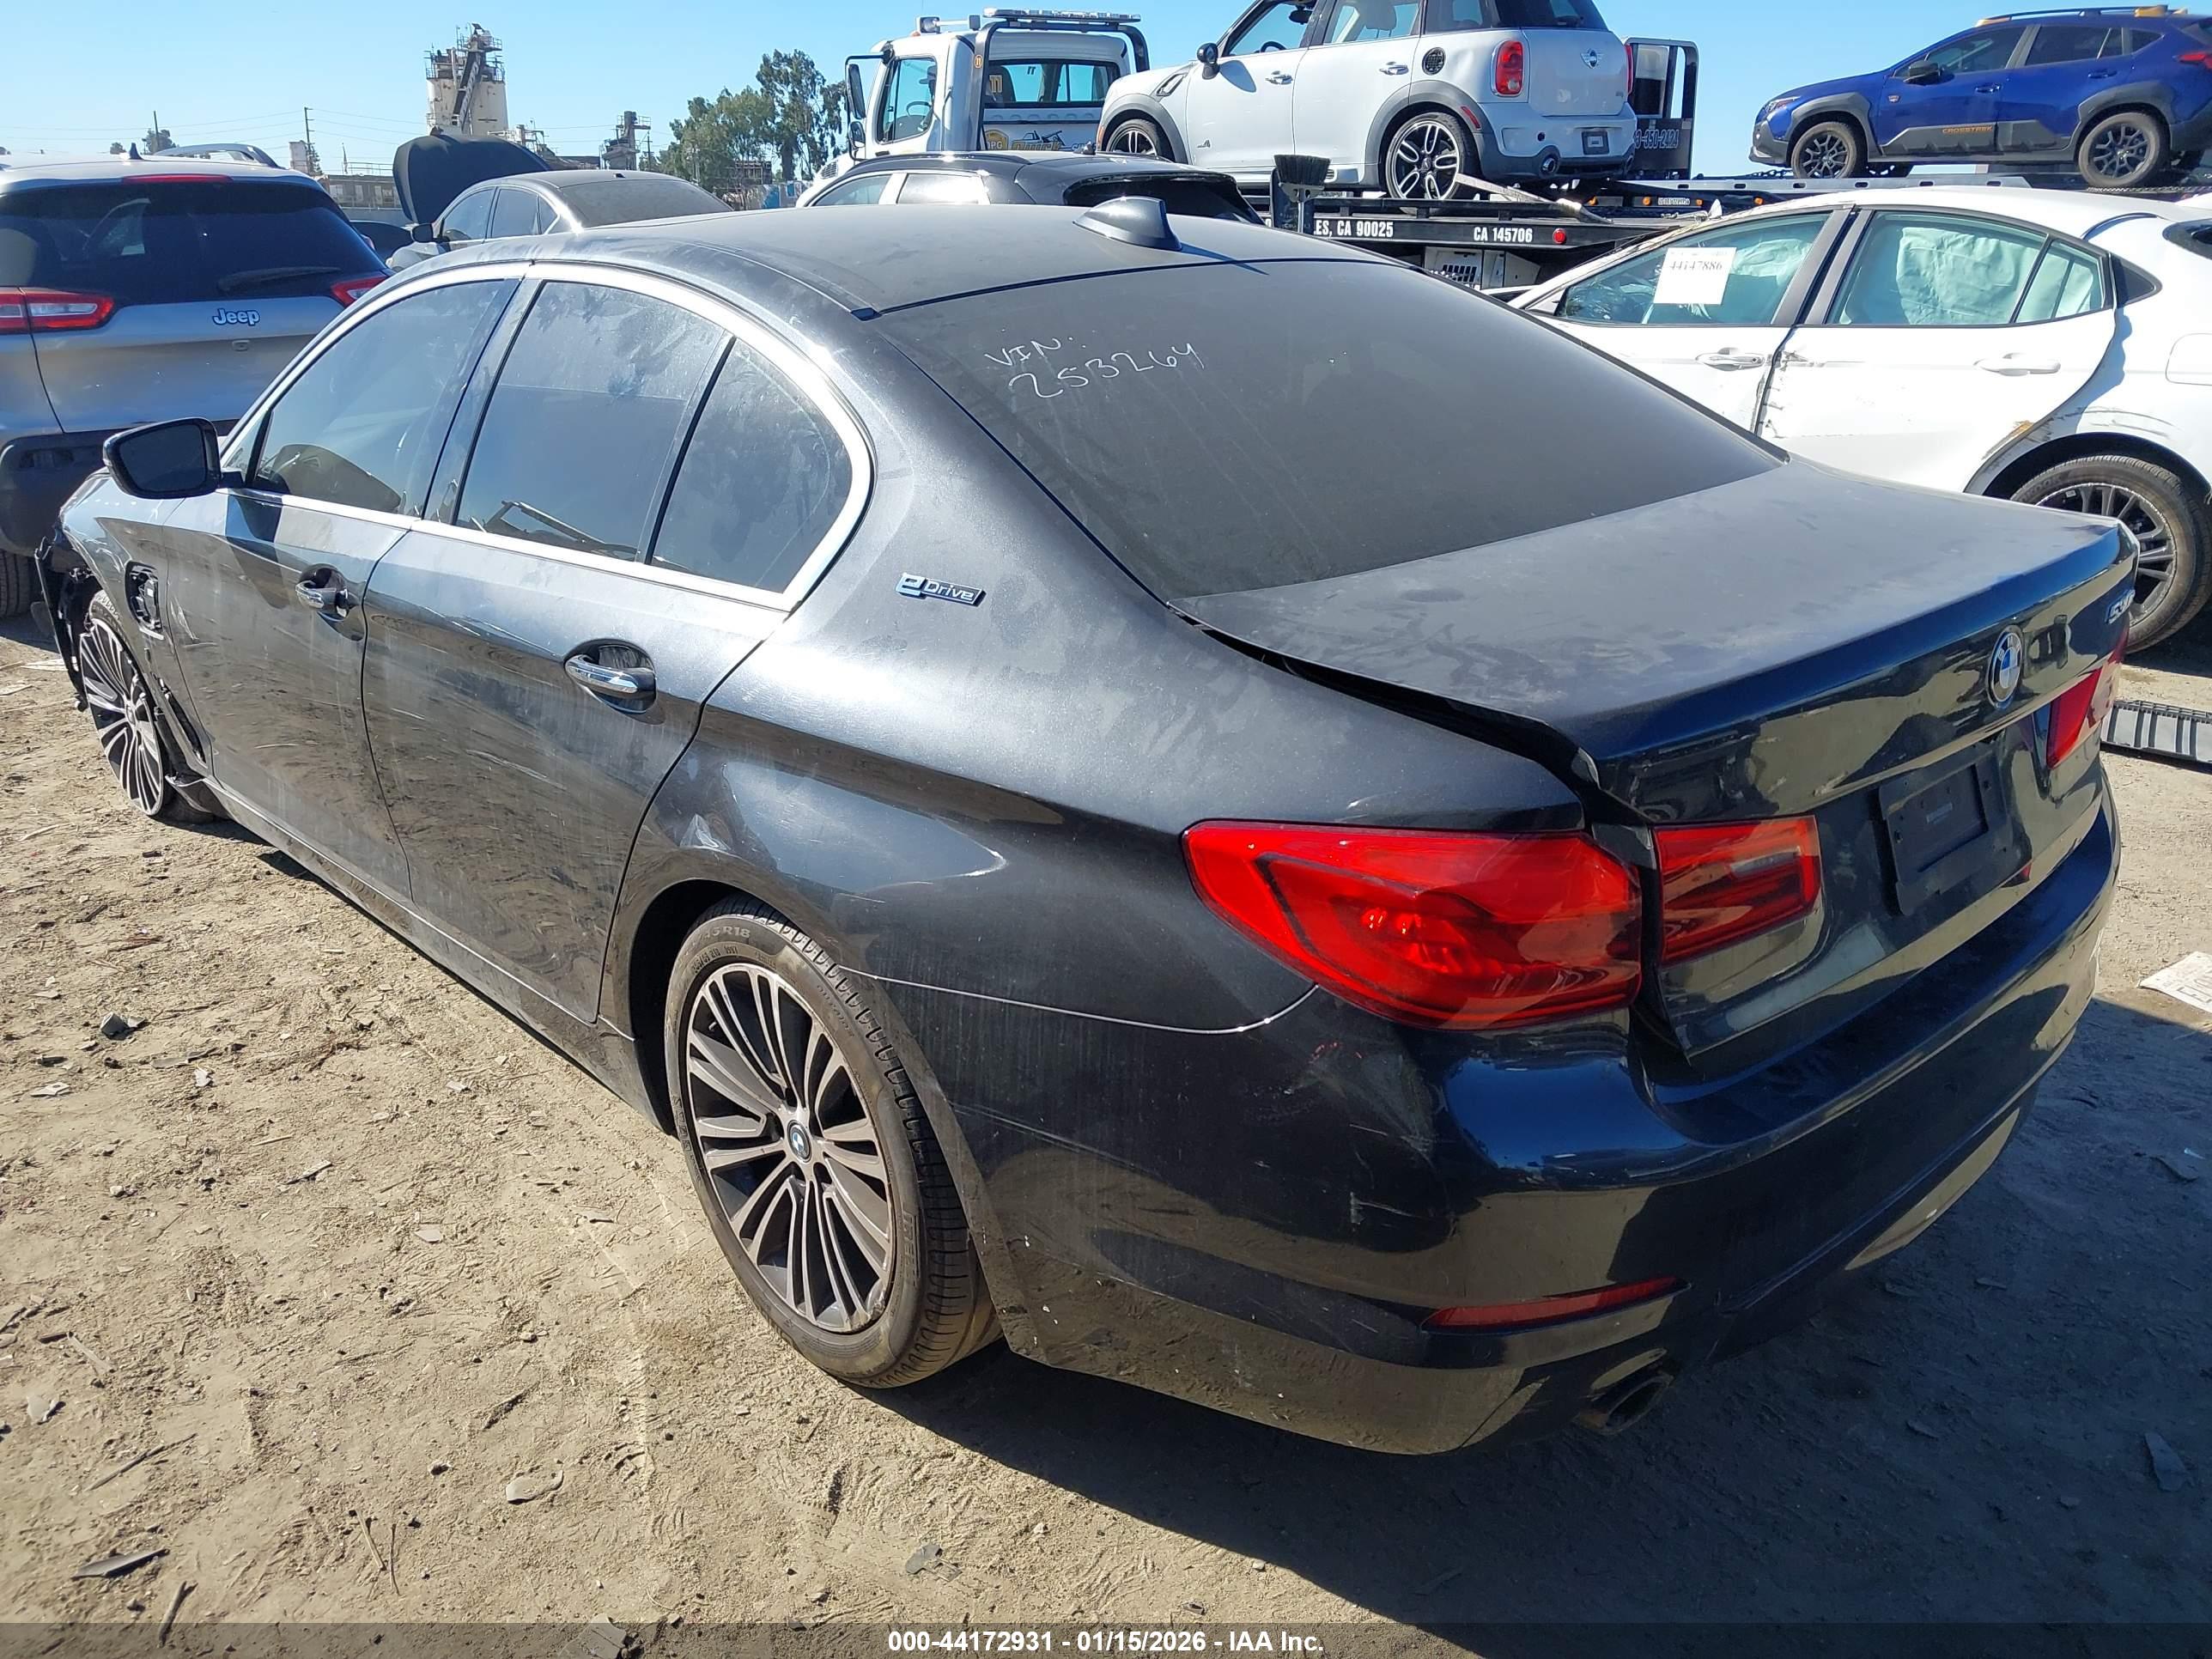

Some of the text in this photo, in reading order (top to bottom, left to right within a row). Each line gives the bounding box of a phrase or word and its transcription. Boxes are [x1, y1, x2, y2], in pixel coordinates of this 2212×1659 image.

[1314, 220, 1394, 238] ES, CA 90025
[1474, 227, 1533, 242] CA 145706
[1669, 260, 1723, 270] 44147886
[213, 308, 260, 326] Jeep
[1008, 343, 1205, 398] 253264
